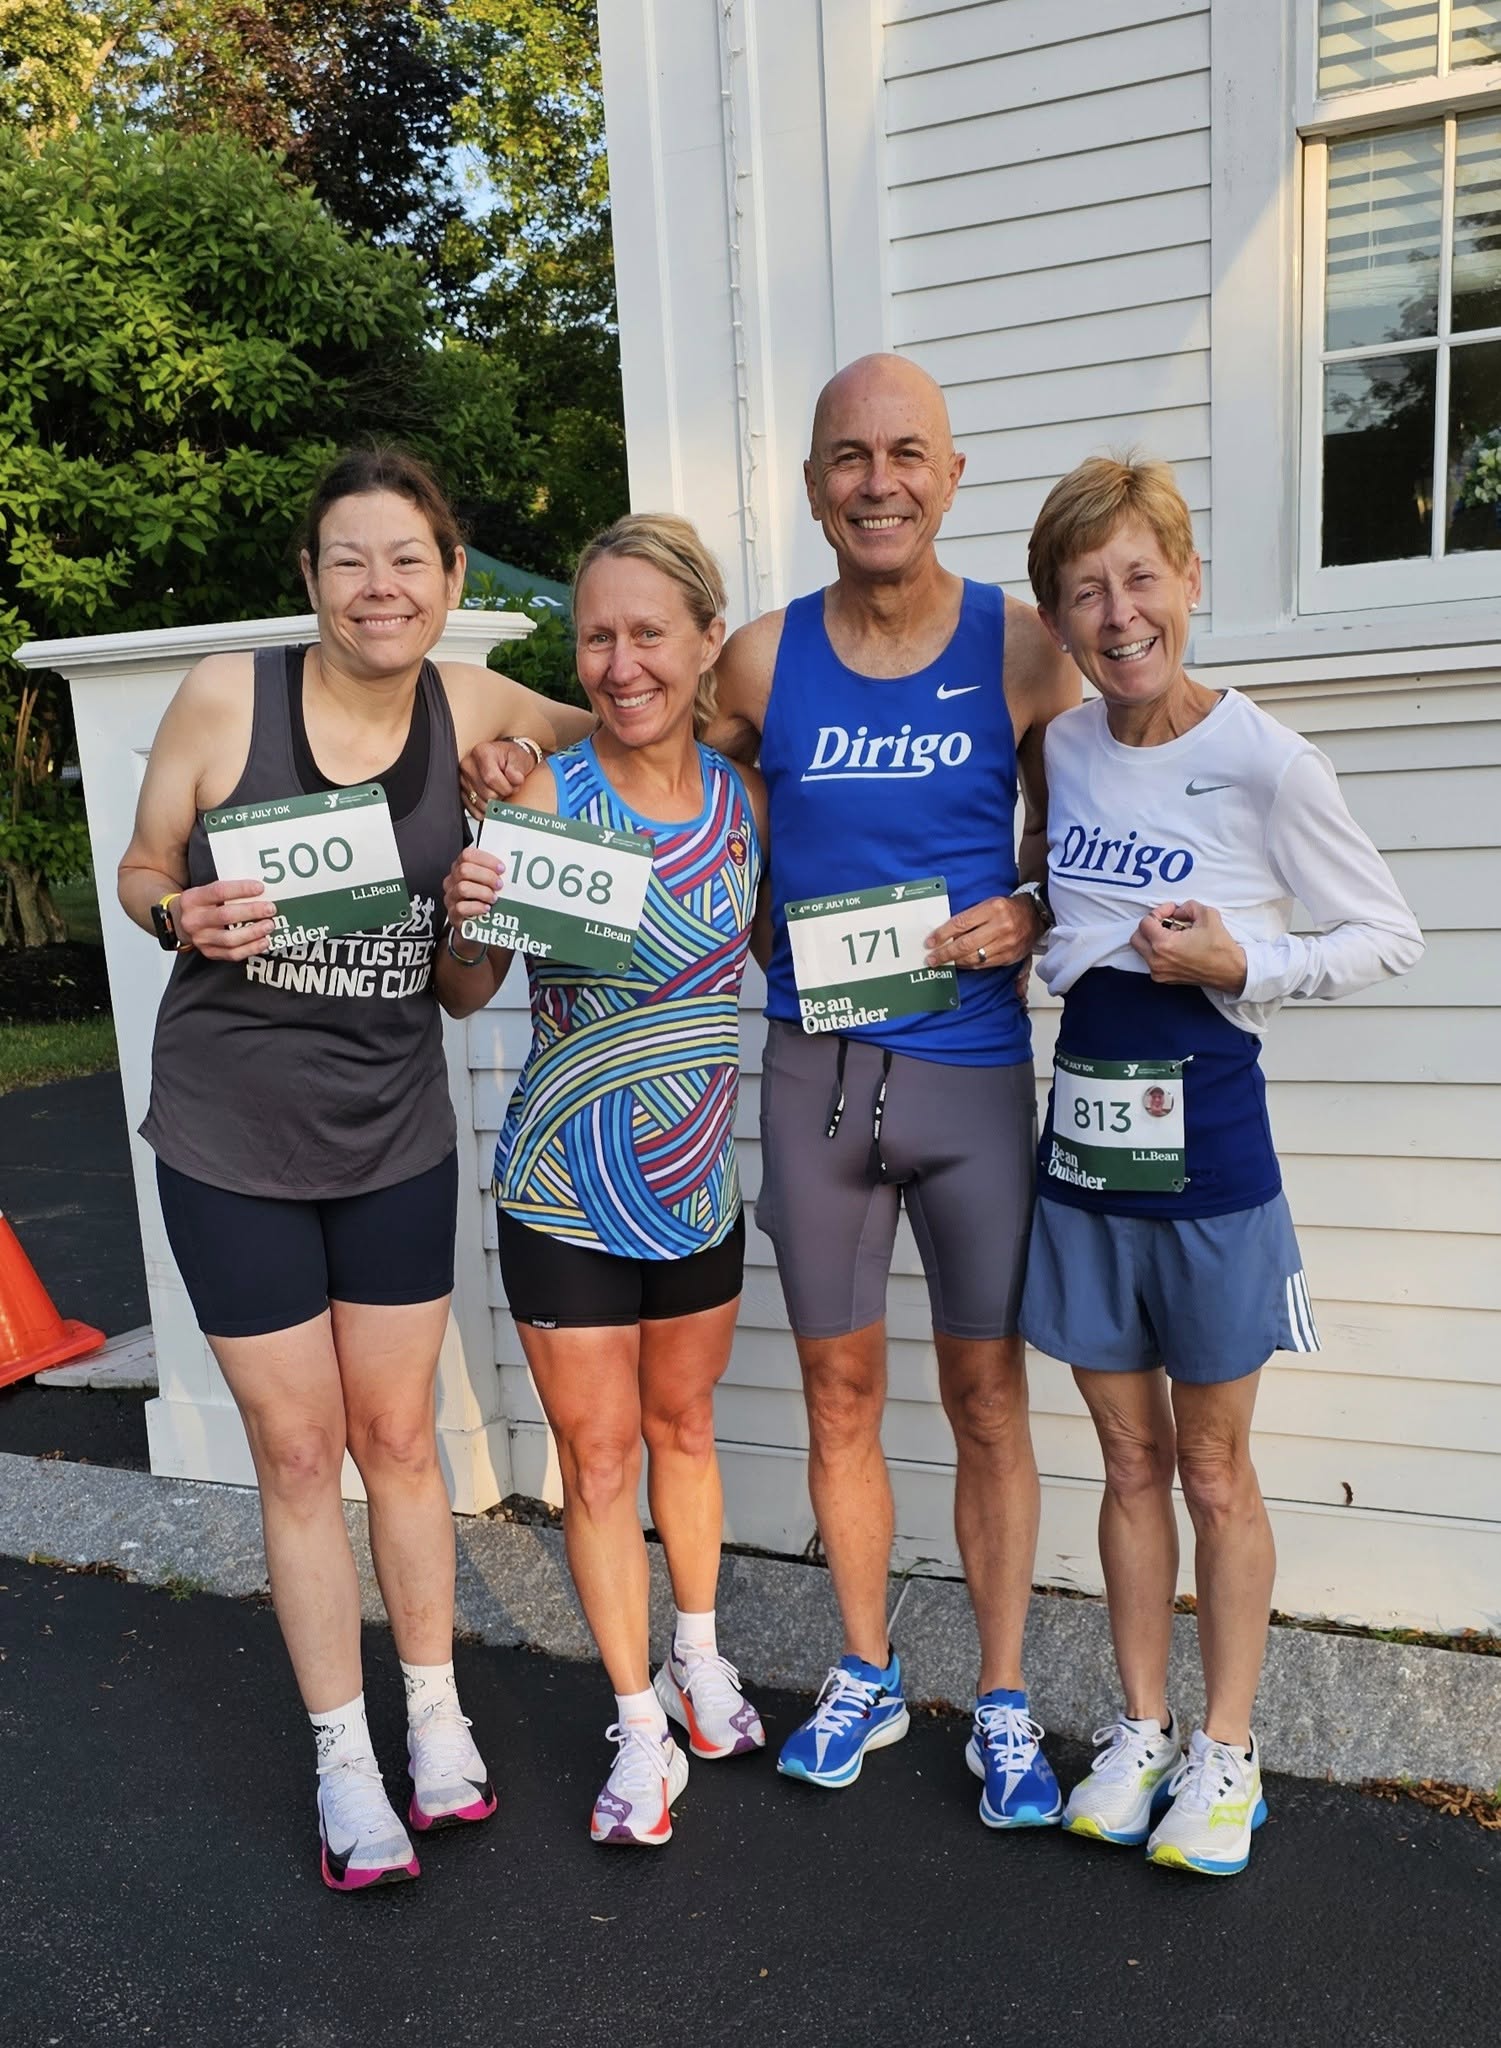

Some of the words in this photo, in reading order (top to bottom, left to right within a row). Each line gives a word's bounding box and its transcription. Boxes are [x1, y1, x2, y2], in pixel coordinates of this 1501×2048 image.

[801, 724, 972, 781] Dirigo
[235, 812, 249, 822] OF
[250, 808, 272, 819] JULY
[273, 805, 291, 815] 10K
[515, 812, 528, 820] OF
[529, 816, 550, 826] JULY
[551, 821, 567, 831] 10K
[258, 836, 353, 884] 500
[1051, 825, 1194, 888] Dirigo
[510, 850, 613, 905] 1068
[351, 882, 401, 901] L.L.Bean
[811, 903, 824, 911] OF
[825, 899, 845, 909] JULY
[845, 896, 860, 906] 10K
[464, 908, 520, 931] ean
[584, 922, 632, 943] L.L.Bean
[263, 925, 330, 954] tsider
[271, 938, 395, 967] ABATTUS
[461, 920, 552, 958] Outsider
[841, 926, 901, 966] 171
[246, 955, 376, 997] RUNNING
[381, 964, 431, 998] CLUB
[910, 970, 953, 983] L.L.Bean
[799, 996, 854, 1017] Bean
[802, 1007, 889, 1034] Outsider
[1082, 1064, 1094, 1072] 10K
[1074, 1097, 1132, 1133] 813
[1051, 1141, 1079, 1168] Bean
[1132, 1151, 1179, 1161] L.L.Bean
[1048, 1159, 1107, 1190] Outsider
